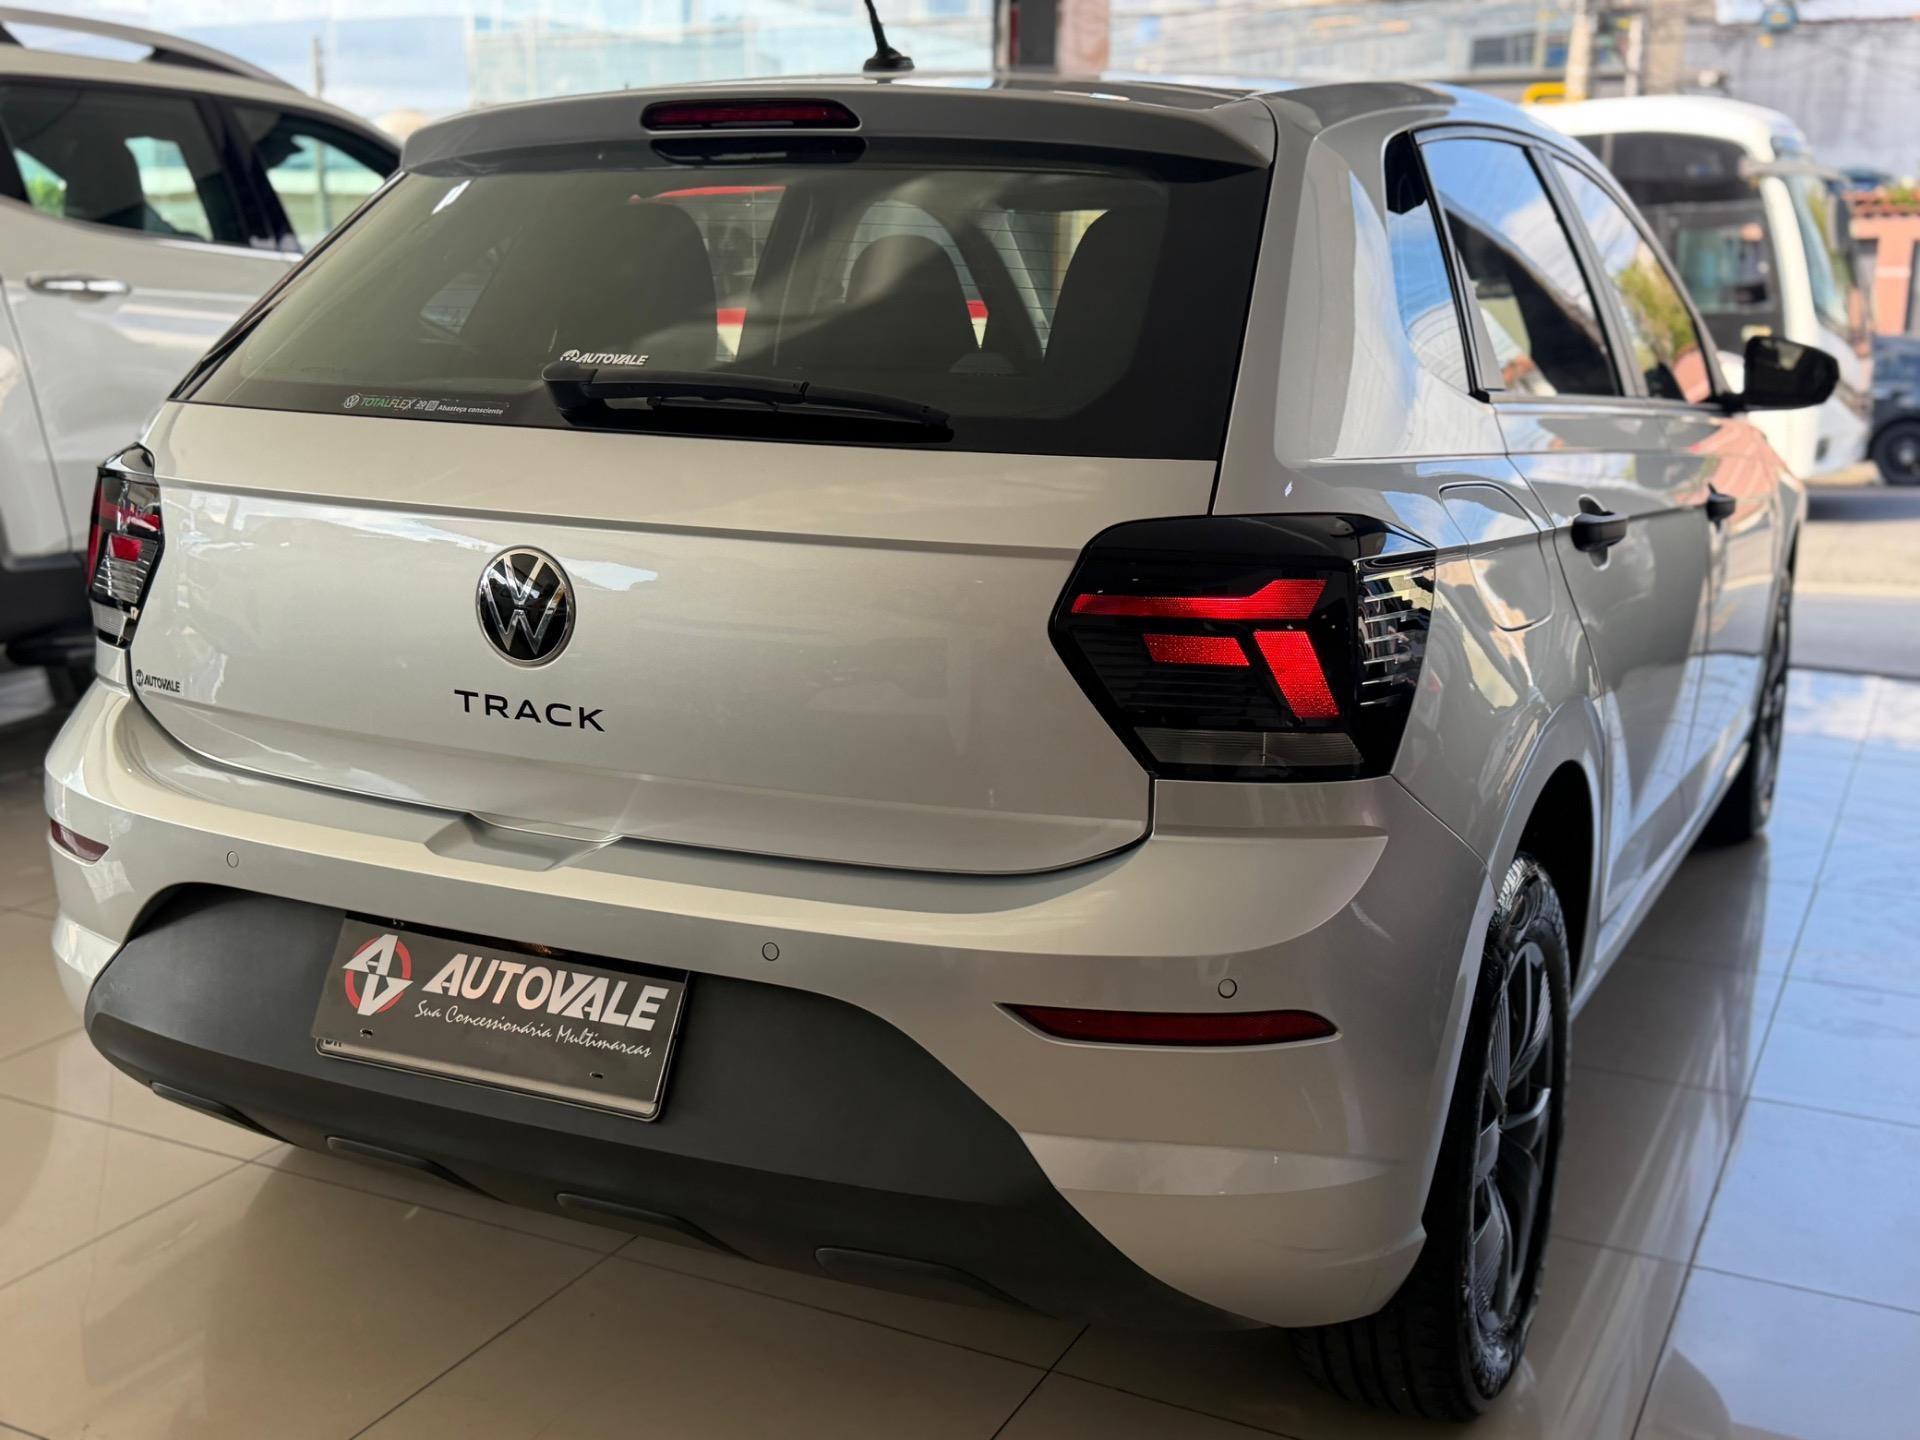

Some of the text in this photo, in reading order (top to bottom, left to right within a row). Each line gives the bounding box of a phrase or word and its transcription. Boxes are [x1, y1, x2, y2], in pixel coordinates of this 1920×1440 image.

[576, 352, 649, 366] AUTOVALE
[144, 674, 181, 693] AUTOVALE
[454, 689, 606, 733] TRACK
[421, 953, 669, 1032] AUTOVALE
[414, 1000, 652, 1058] Sua Concessionária Multimarcas
